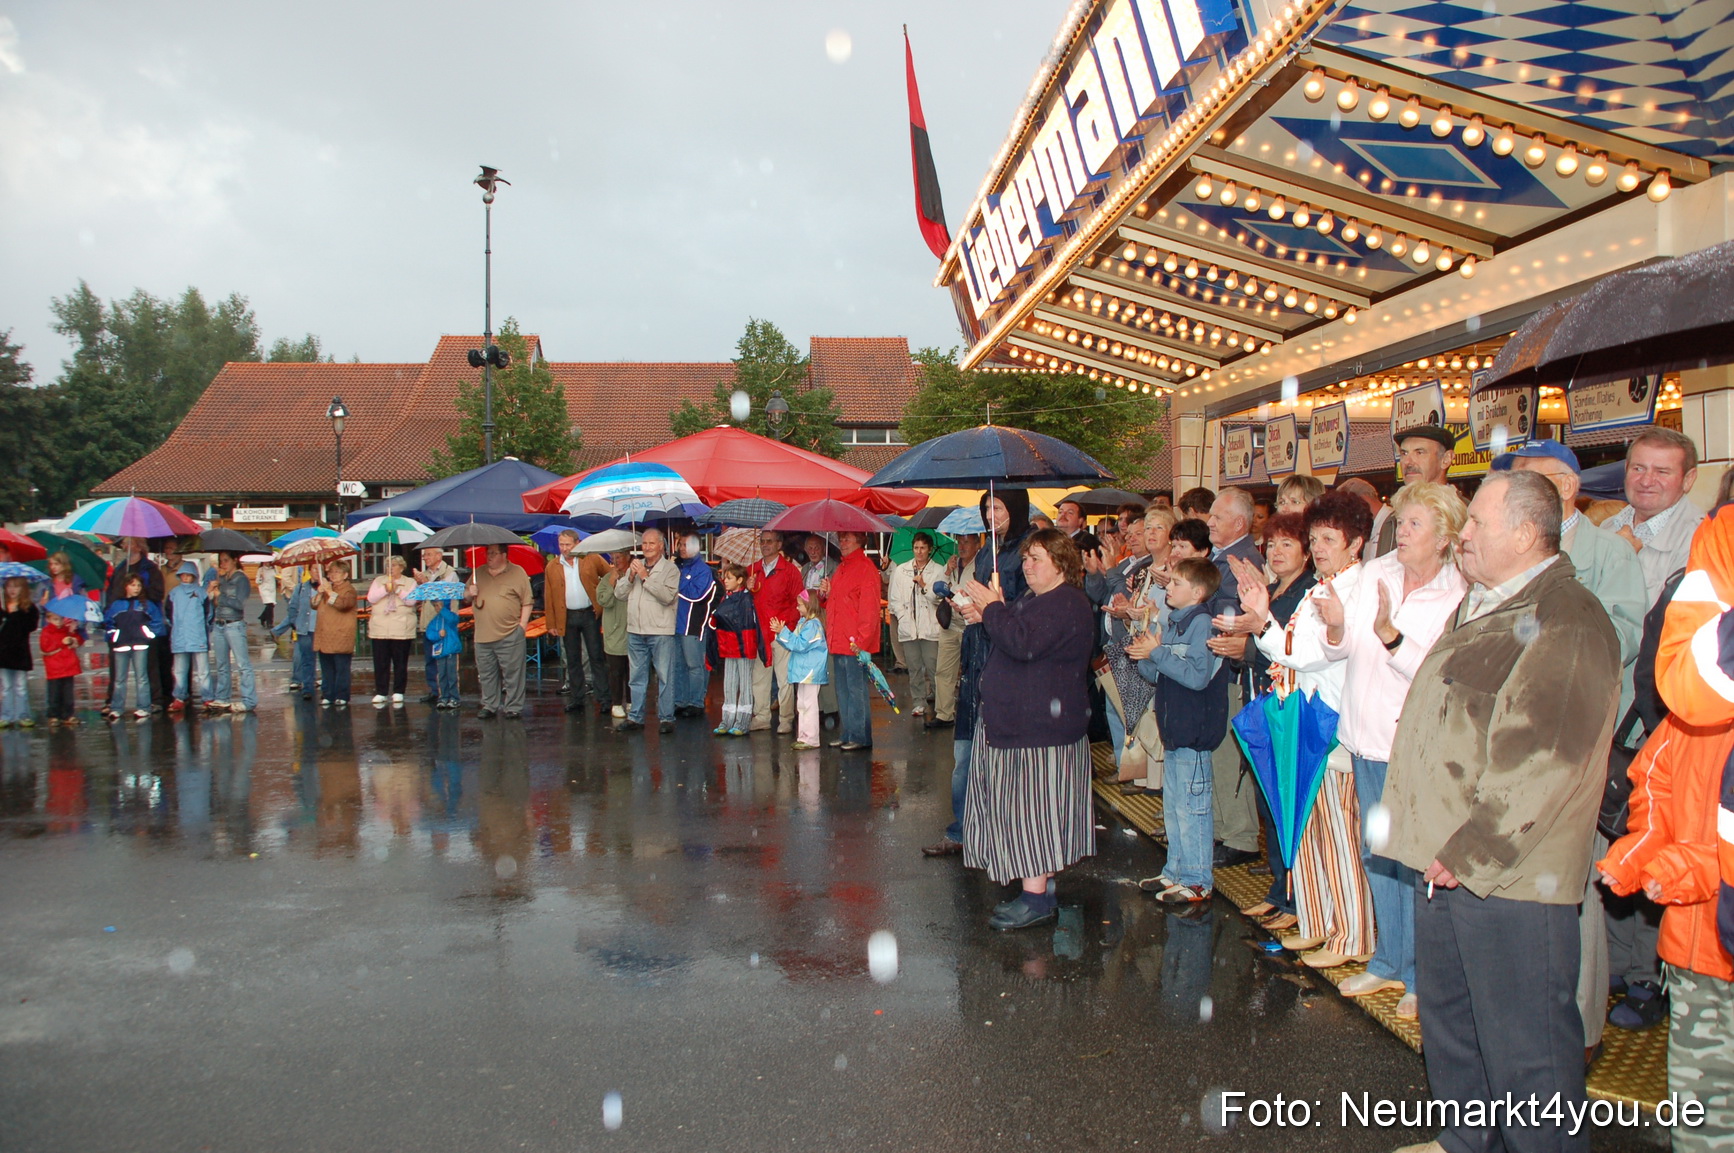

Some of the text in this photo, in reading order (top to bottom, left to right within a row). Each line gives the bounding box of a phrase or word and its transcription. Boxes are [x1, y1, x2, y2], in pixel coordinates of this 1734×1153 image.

[1477, 386, 1523, 403] Currywurs
[342, 482, 357, 494] WC
[608, 486, 641, 494] SACHS
